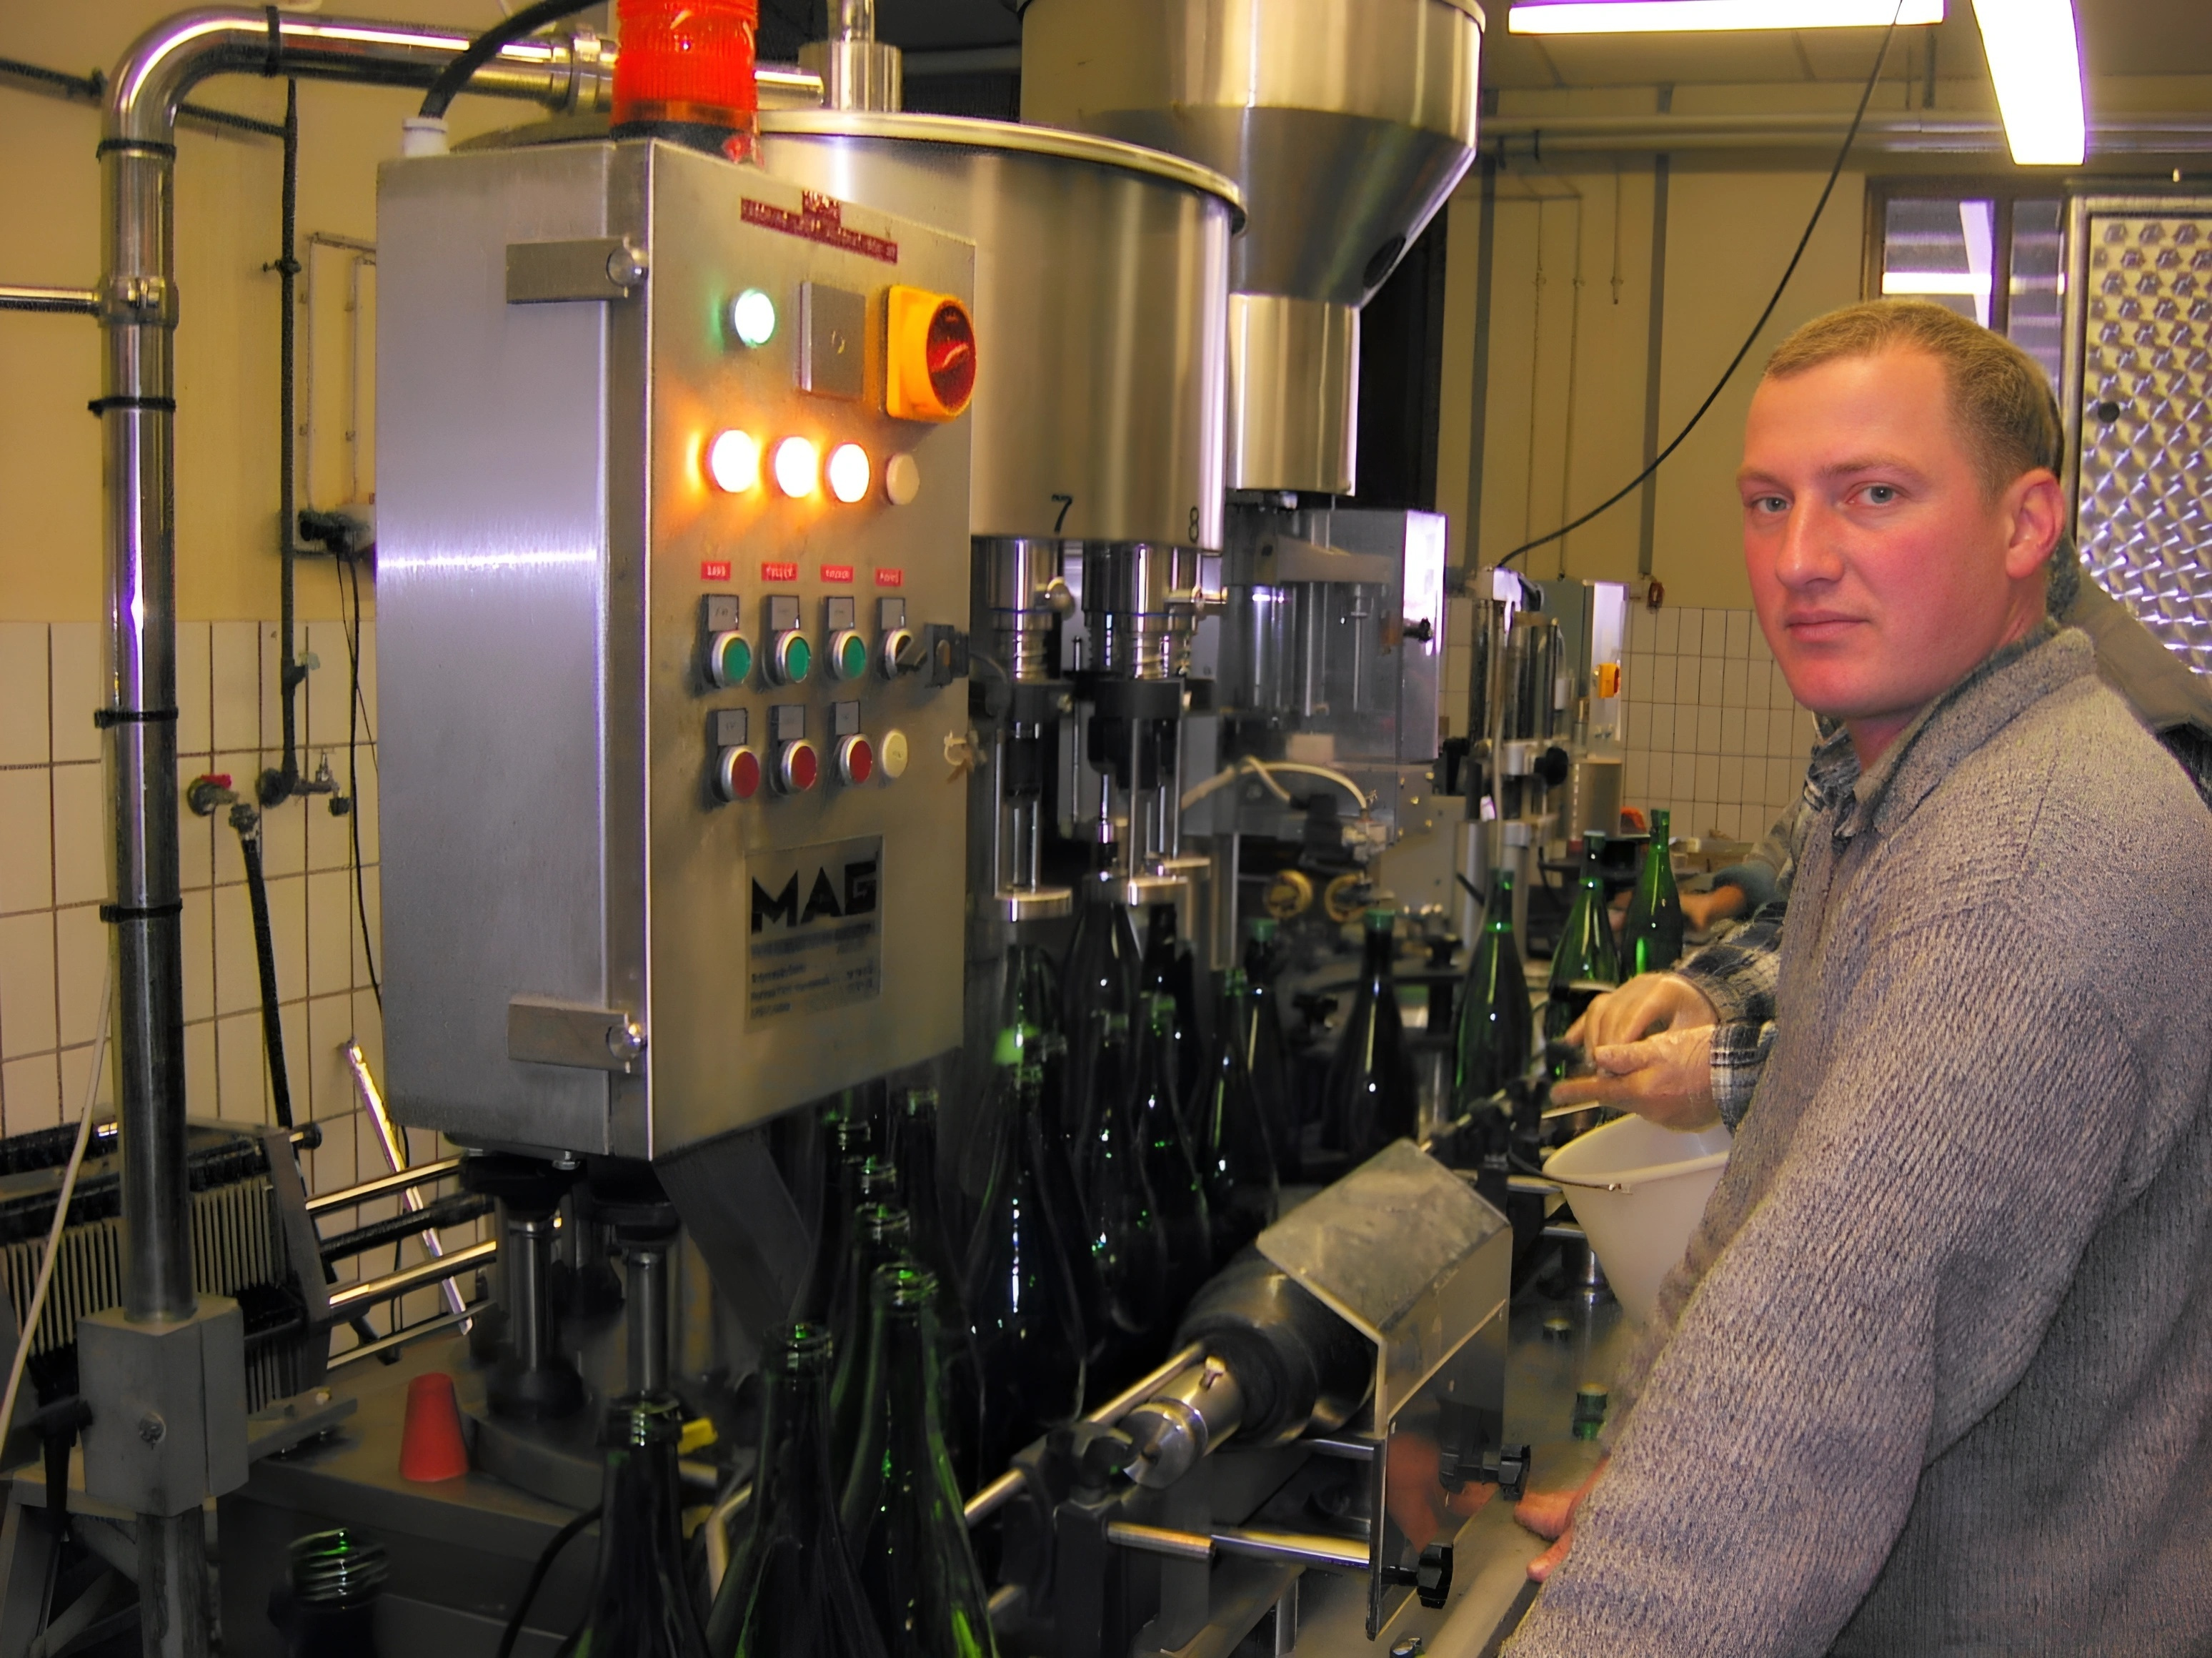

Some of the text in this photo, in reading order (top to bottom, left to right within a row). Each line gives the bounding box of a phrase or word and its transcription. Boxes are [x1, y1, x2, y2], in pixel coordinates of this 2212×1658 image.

[1052, 494, 1073, 534] 7
[1188, 505, 1200, 543] 8
[751, 860, 877, 935] MAG
